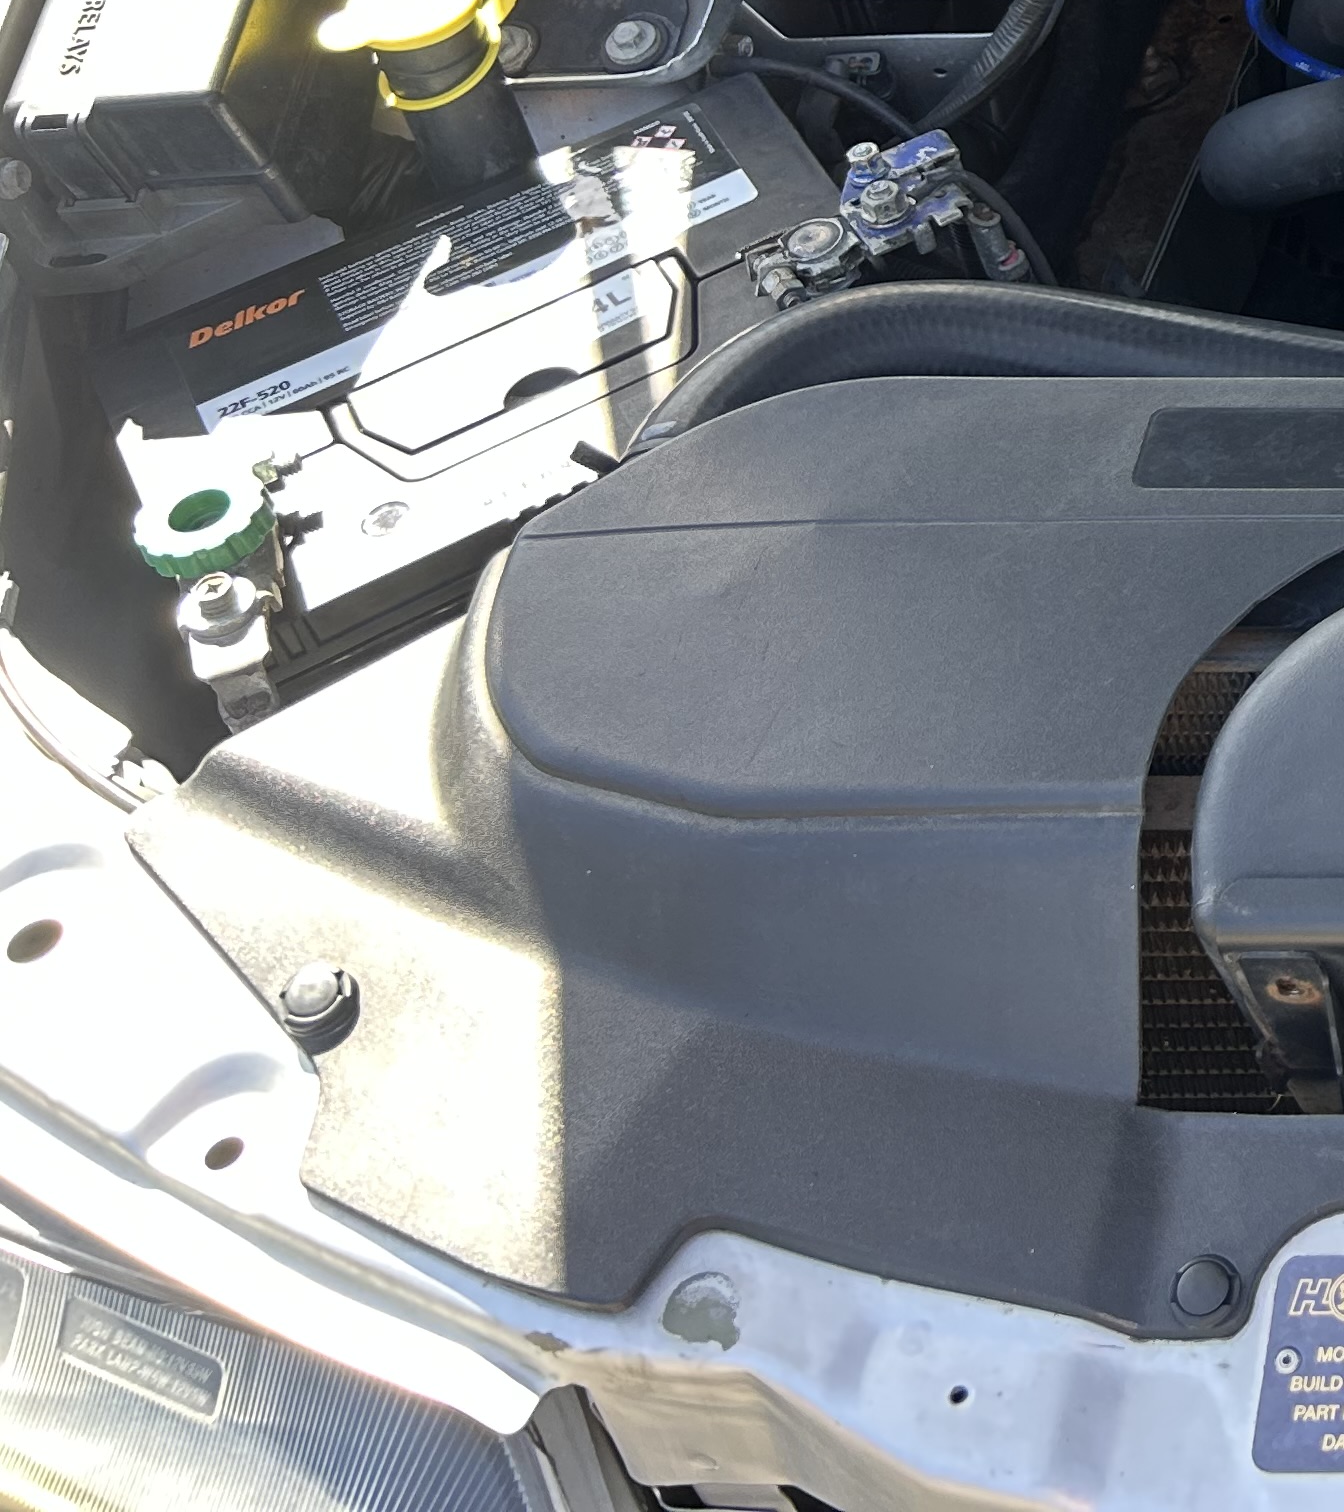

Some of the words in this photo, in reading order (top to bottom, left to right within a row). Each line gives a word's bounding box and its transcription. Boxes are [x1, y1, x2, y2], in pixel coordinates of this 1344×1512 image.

[59, 0, 106, 75] RELAYS
[189, 289, 306, 349] Delkor
[216, 380, 291, 419] 22F-520
[1289, 1374, 1344, 1393] BUILD
[1292, 1404, 1340, 1422] PART
